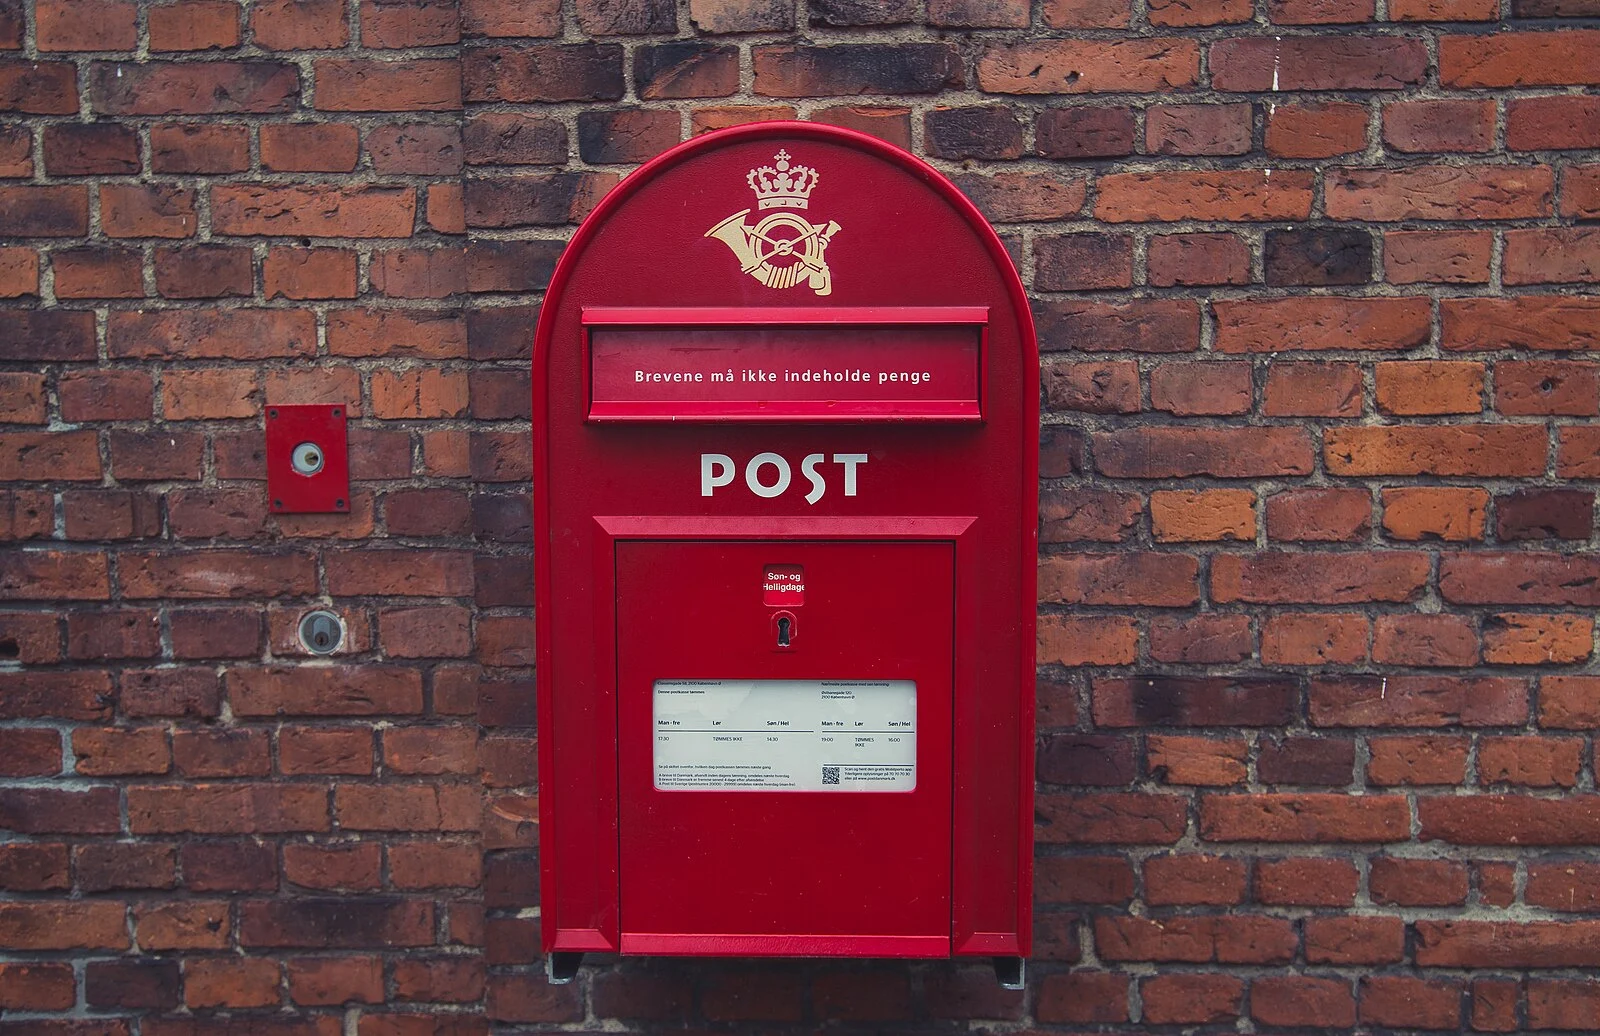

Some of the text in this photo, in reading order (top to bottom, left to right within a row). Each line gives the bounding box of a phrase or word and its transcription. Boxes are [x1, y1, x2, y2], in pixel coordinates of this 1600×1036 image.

[635, 369, 931, 384] Brevene må ikke indeholde penge
[701, 452, 868, 505] POST
